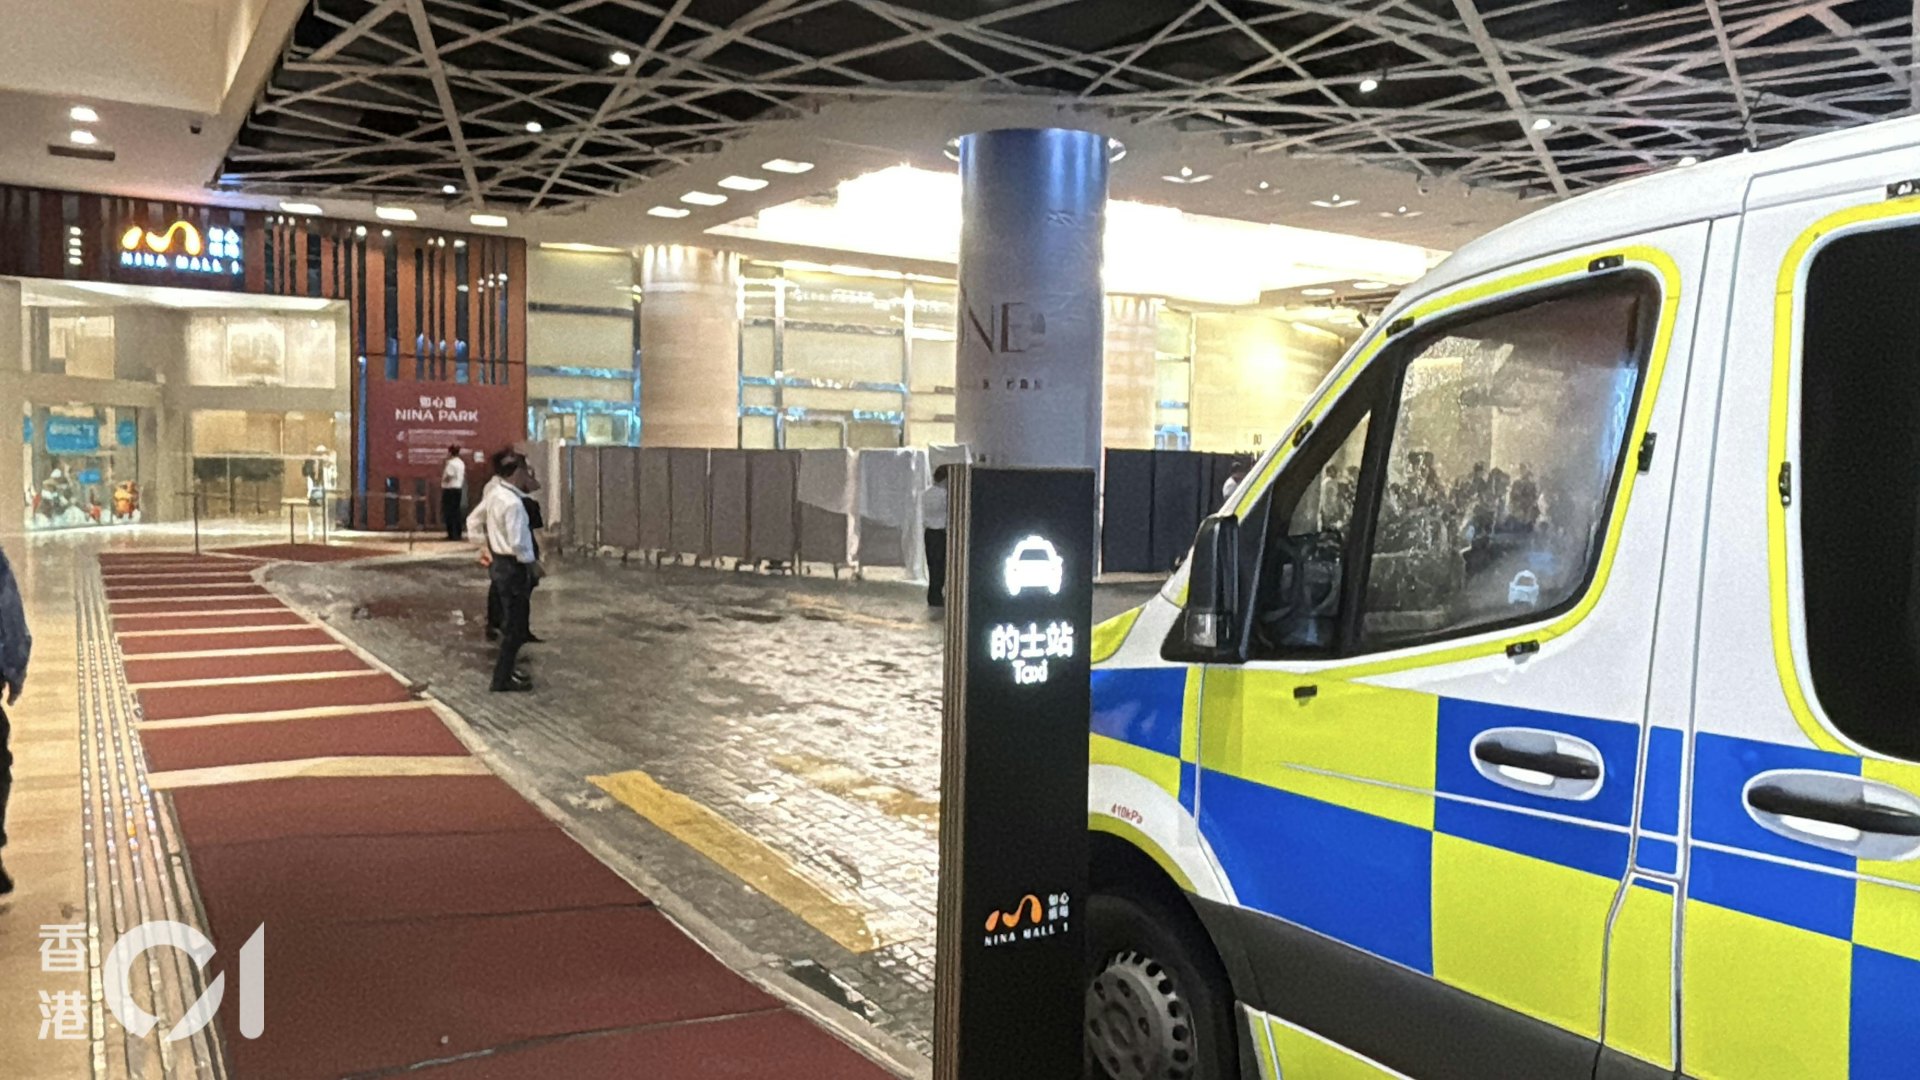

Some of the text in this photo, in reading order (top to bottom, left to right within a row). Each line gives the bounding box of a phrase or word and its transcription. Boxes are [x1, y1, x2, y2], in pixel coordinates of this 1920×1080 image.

[121, 251, 168, 268] NINA
[395, 408, 479, 422] NINA PARK
[990, 621, 1074, 661] 的士站
[1012, 659, 1049, 685] Taxi
[984, 931, 1016, 947] NINA
[1023, 925, 1055, 940] MALL
